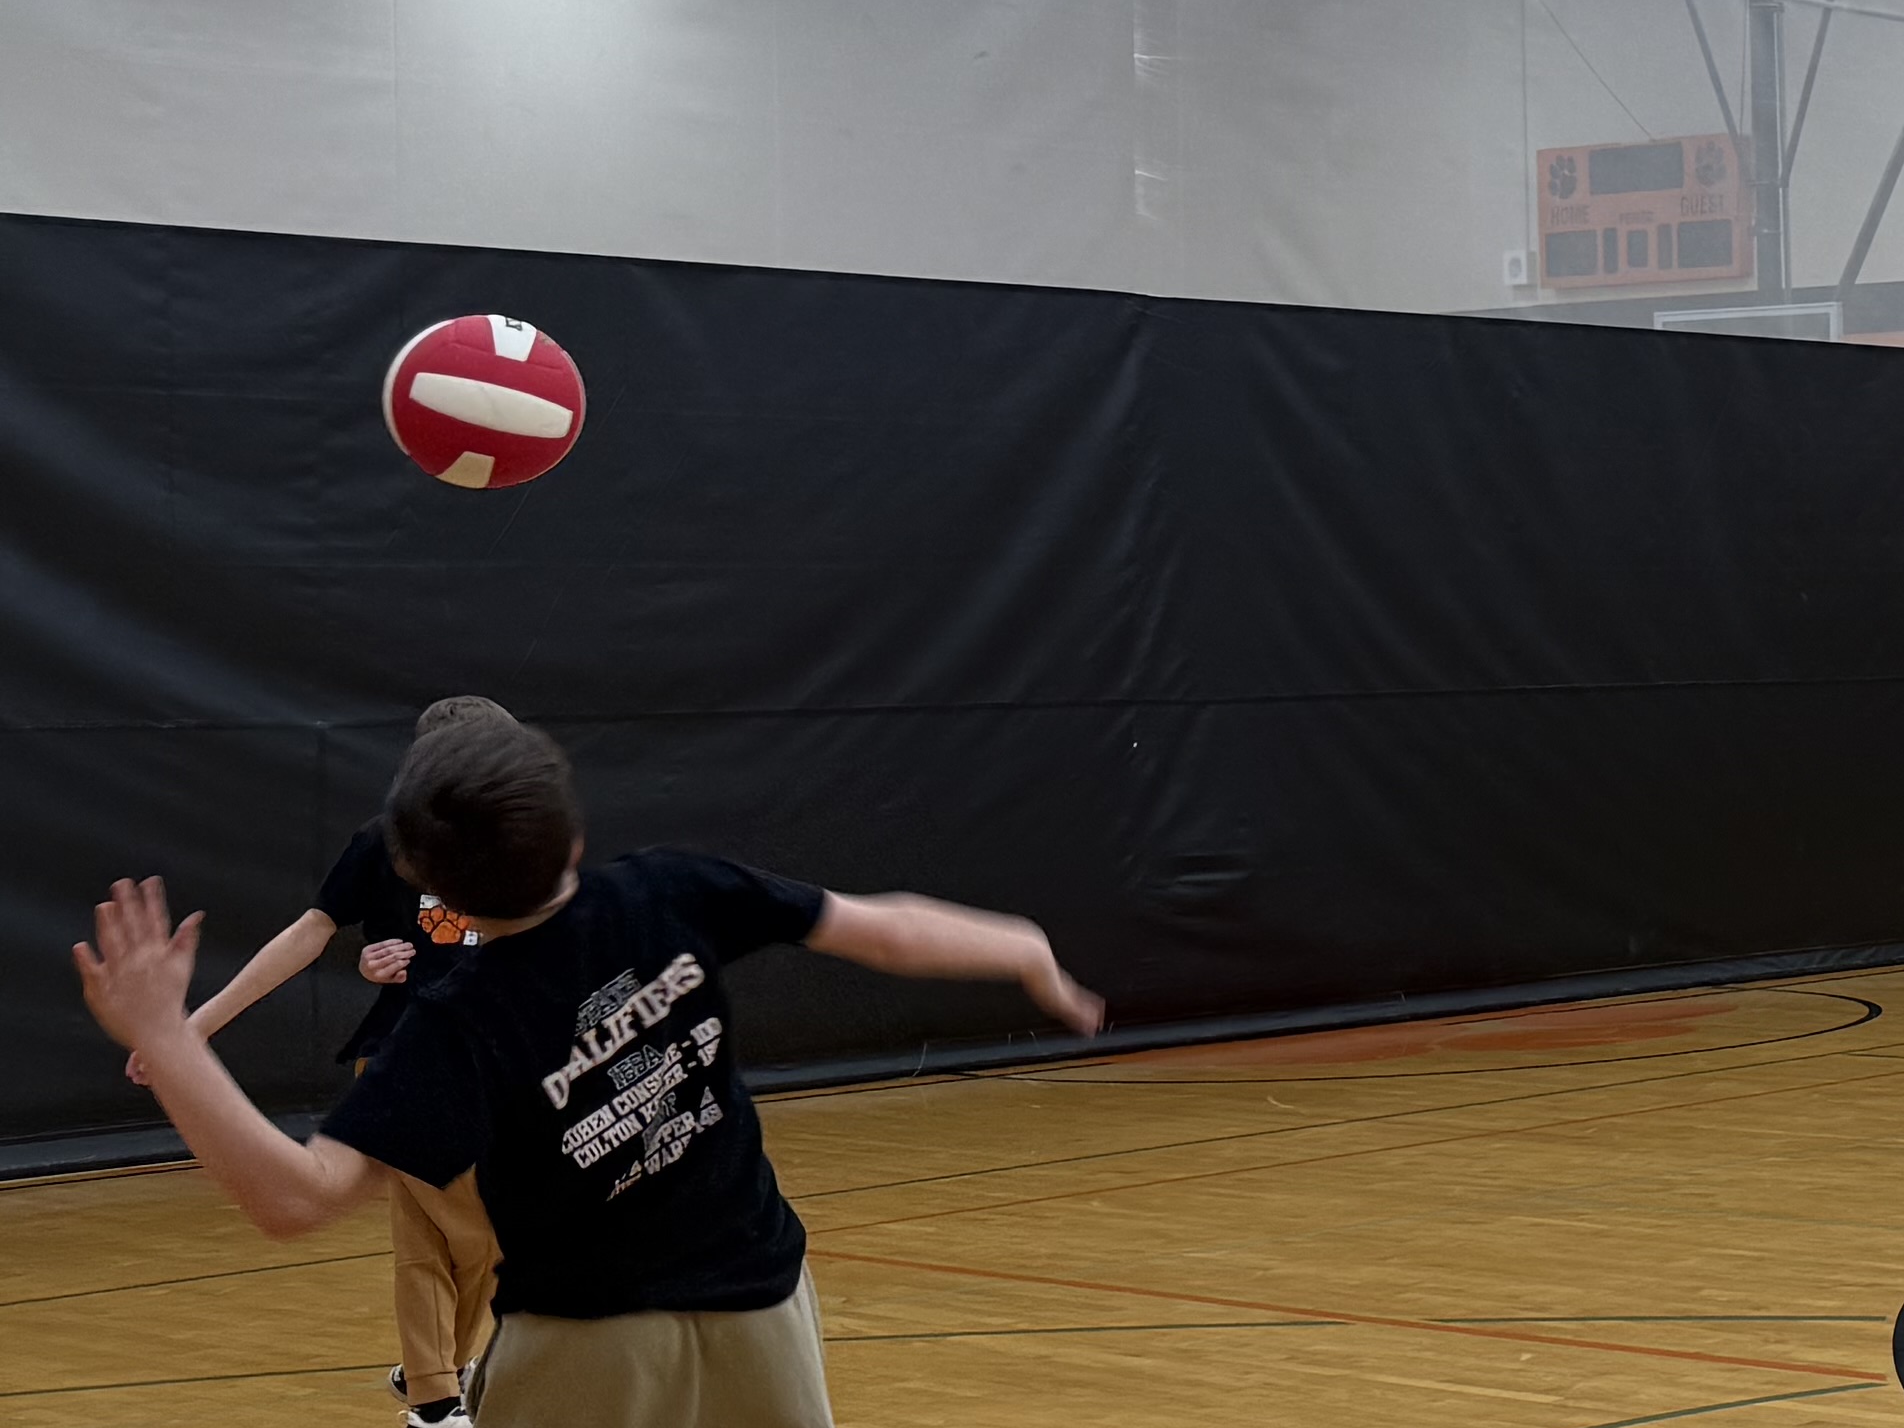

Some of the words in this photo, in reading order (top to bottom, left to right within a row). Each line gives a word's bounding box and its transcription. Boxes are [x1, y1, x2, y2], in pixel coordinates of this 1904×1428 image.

[1680, 194, 1725, 217] GUEST
[541, 953, 705, 1110] ALIFIERS
[573, 1113, 644, 1169] COLTON
